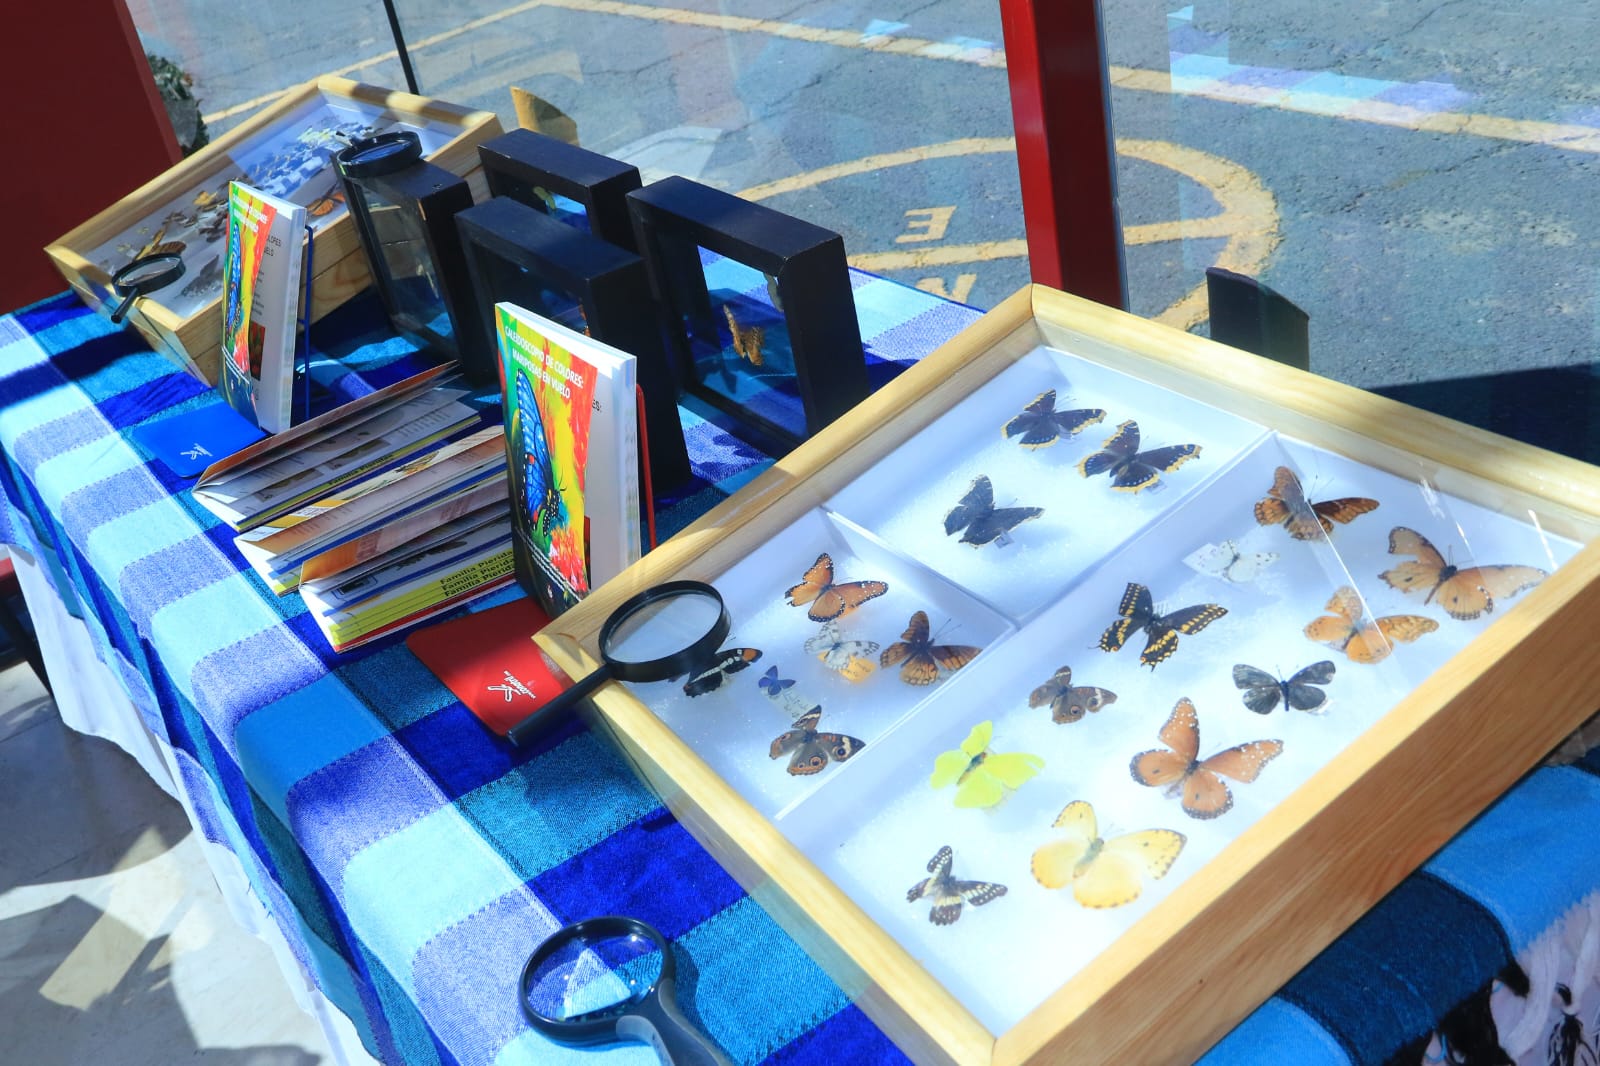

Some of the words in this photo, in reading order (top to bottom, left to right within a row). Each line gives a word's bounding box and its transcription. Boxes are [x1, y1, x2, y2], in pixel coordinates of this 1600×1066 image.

[505, 325, 545, 362] CALEIDOSCOPIO
[545, 354, 554, 369] DE
[554, 361, 584, 389] COLORES:
[512, 347, 542, 378] MARIPOSAS
[542, 371, 552, 386] EN
[551, 378, 571, 399] VUELO
[592, 399, 602, 413] ES:
[440, 567, 476, 585] Familia
[478, 551, 513, 568] Pierida
[441, 573, 478, 591] Familia
[444, 578, 480, 597] Familia
[482, 565, 512, 581] Pierid
